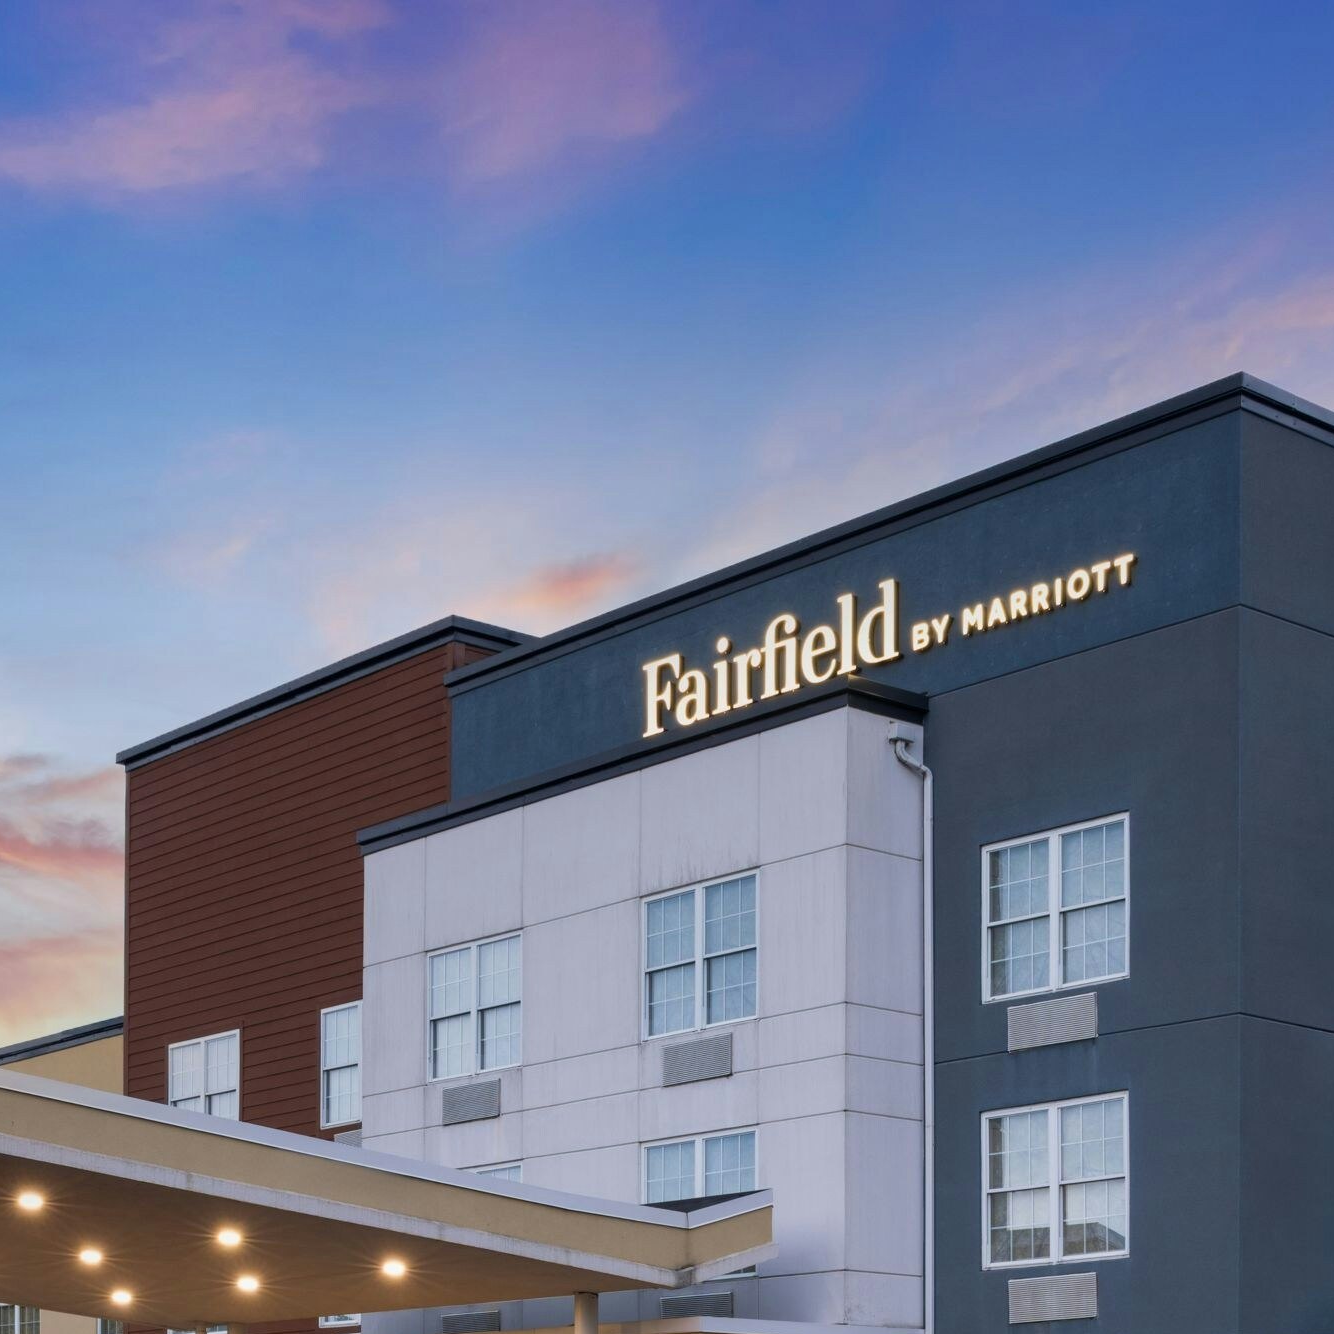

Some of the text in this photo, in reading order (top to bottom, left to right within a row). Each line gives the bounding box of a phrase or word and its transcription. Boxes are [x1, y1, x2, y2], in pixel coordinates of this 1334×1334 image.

[641, 553, 1135, 739] Fairfield BY MARRIOTT
